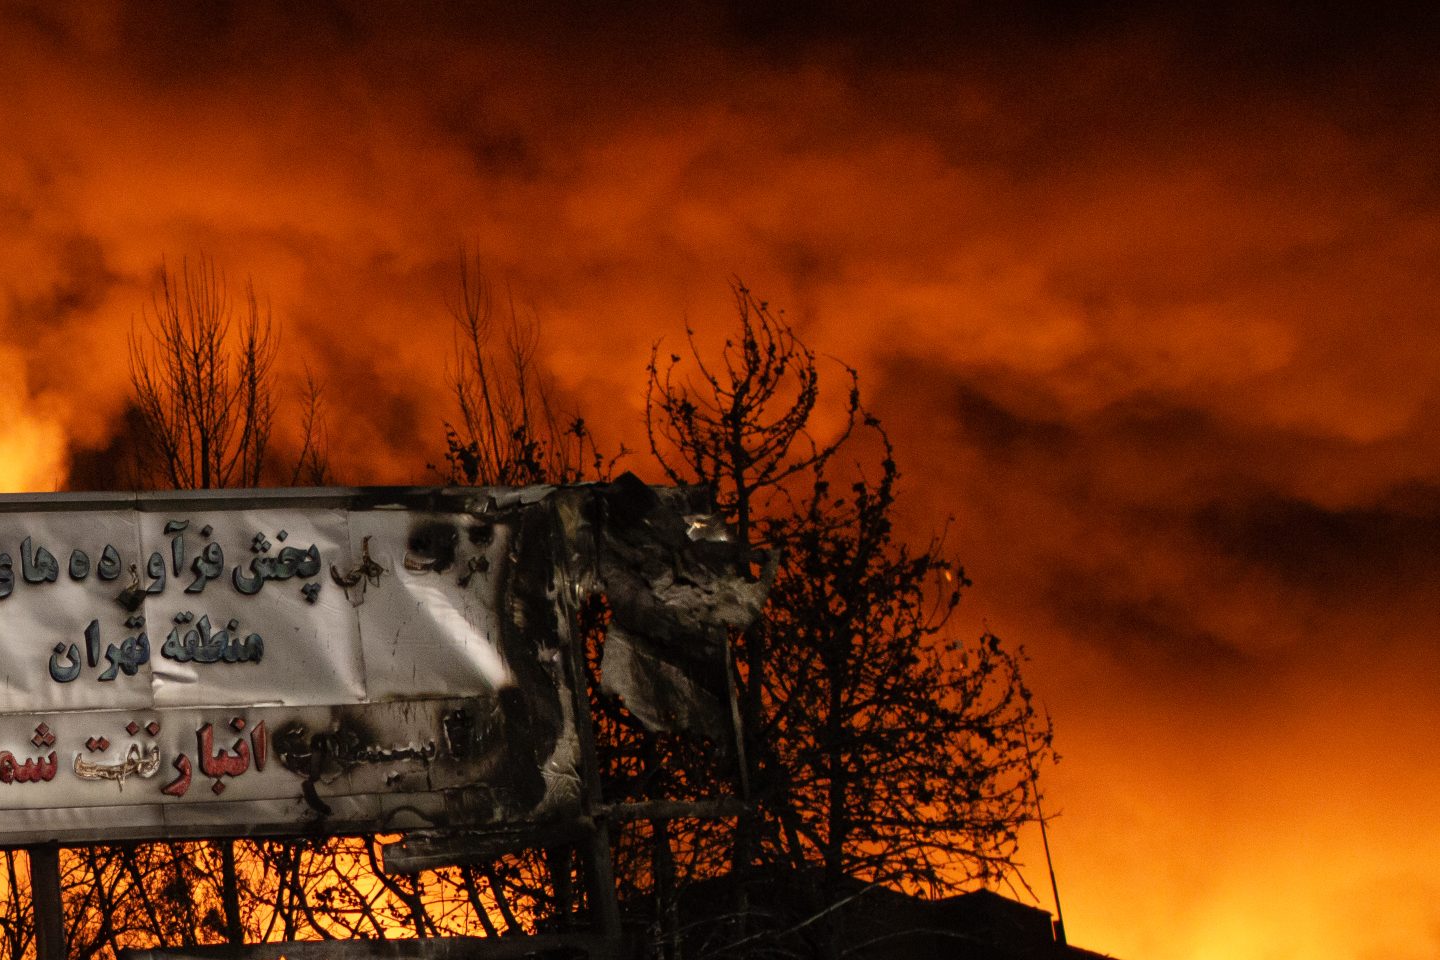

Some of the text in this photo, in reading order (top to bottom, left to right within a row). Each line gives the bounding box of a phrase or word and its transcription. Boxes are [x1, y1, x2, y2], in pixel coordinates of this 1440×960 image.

[231, 529, 323, 604] پخش
[48, 610, 264, 683] منطقه تهران
[160, 716, 269, 797] انبار
